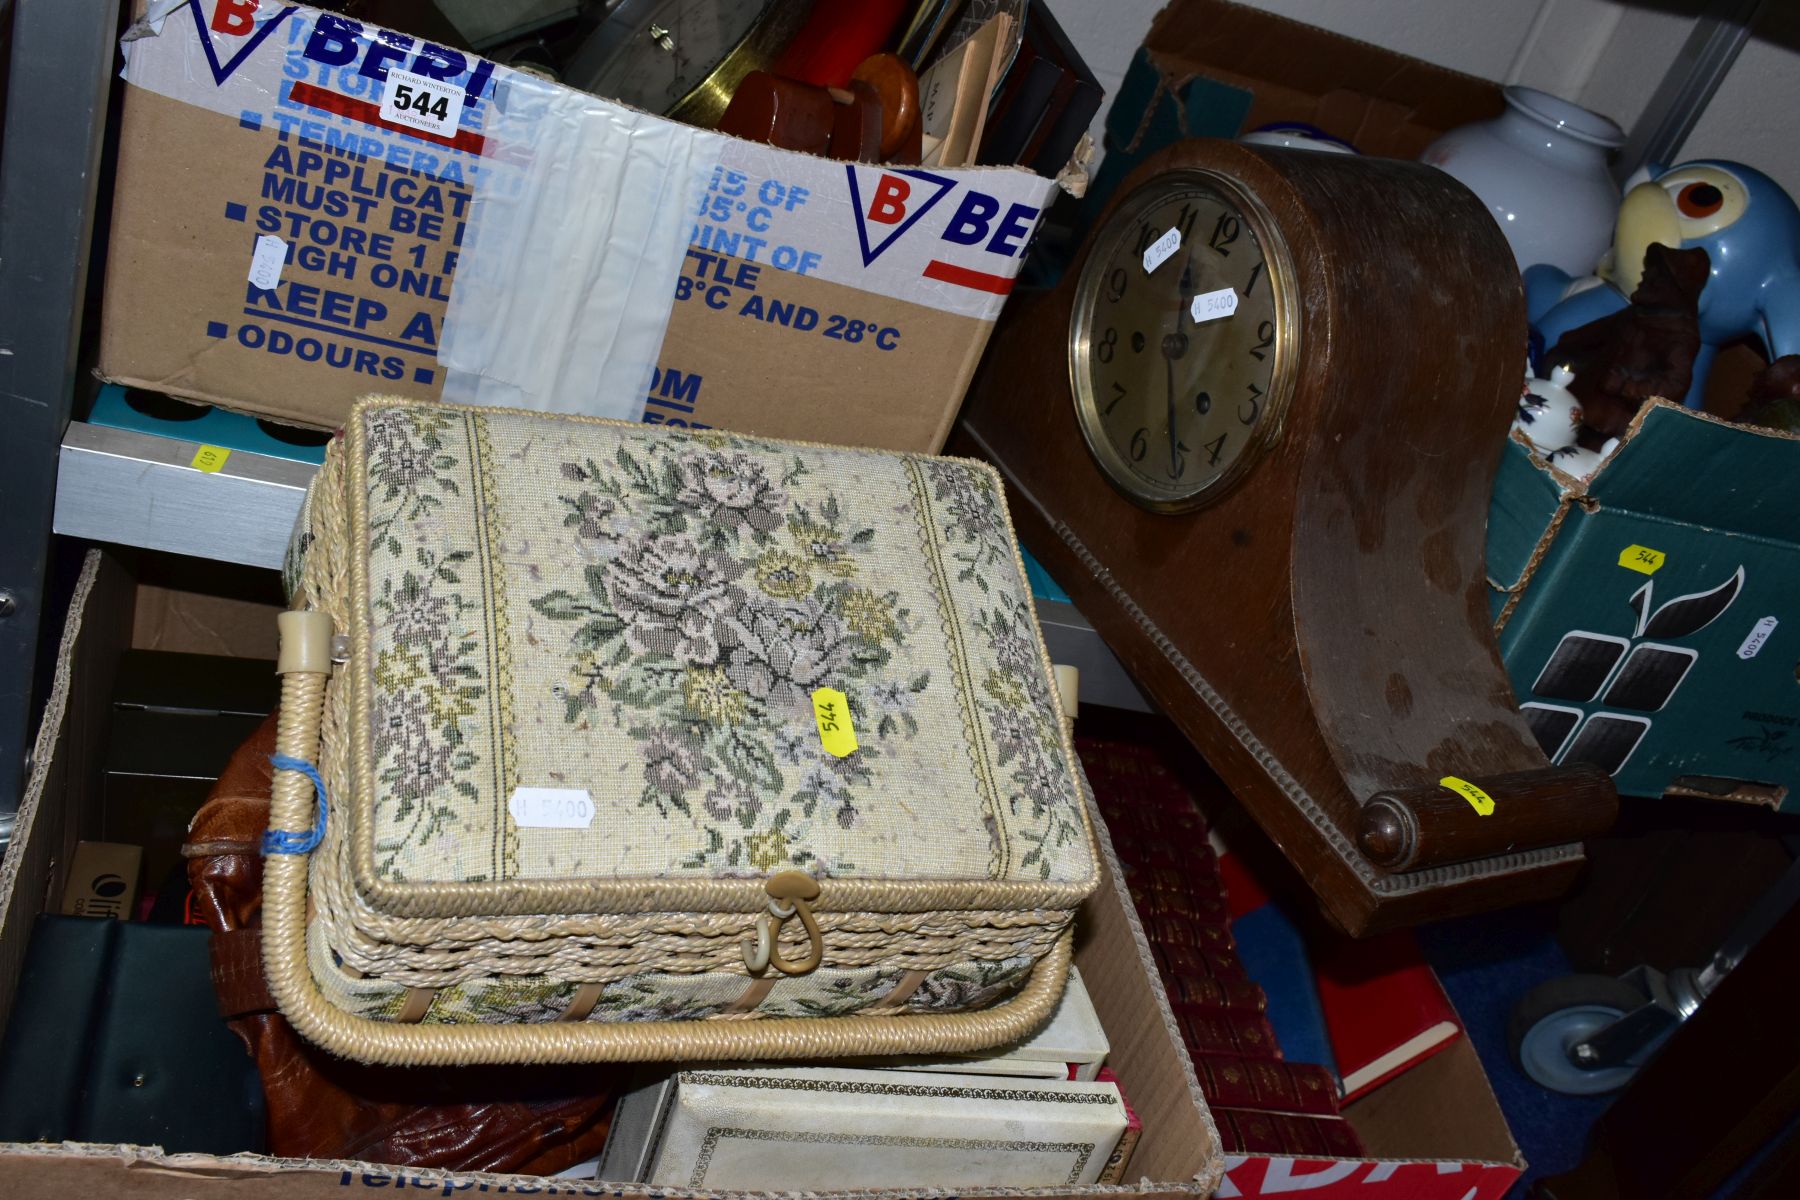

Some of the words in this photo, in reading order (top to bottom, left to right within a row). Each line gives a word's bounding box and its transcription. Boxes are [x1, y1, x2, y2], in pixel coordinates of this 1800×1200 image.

[211, 0, 259, 36] B
[303, 13, 512, 114] BERI
[391, 71, 422, 86] RICHARD
[422, 80, 461, 97] WINTERTON
[393, 84, 449, 121] 544
[395, 113, 441, 130] AUCTIONEERS
[261, 172, 378, 224] MUST
[389, 206, 444, 241] BE
[758, 180, 810, 211] OF
[867, 174, 912, 226] B
[941, 190, 1039, 259] BE
[1177, 203, 1199, 247] 11
[1208, 211, 1240, 258] 12
[256, 205, 395, 261] STORE
[408, 244, 426, 269] 1
[1145, 255, 1154, 269] H
[1155, 232, 1179, 260] 5400
[771, 245, 822, 275] OF
[370, 263, 450, 302] ONL
[1106, 268, 1129, 304] 9
[1243, 262, 1263, 298] 1
[246, 280, 388, 330] KEEP
[1193, 300, 1201, 316] H
[1207, 294, 1233, 312] 5400
[740, 295, 819, 333] AND
[823, 314, 901, 353] 28°C
[1249, 320, 1275, 361] 2
[237, 324, 406, 380] ODOURS
[1097, 327, 1118, 365] 8
[1101, 381, 1127, 417] 7
[1237, 384, 1264, 426] 3
[1130, 427, 1150, 462] 6
[1203, 432, 1228, 467] 4
[1636, 549, 1659, 566] 544
[1743, 632, 1767, 656] 5400
[822, 701, 838, 733] 544
[1461, 783, 1485, 805] 544
